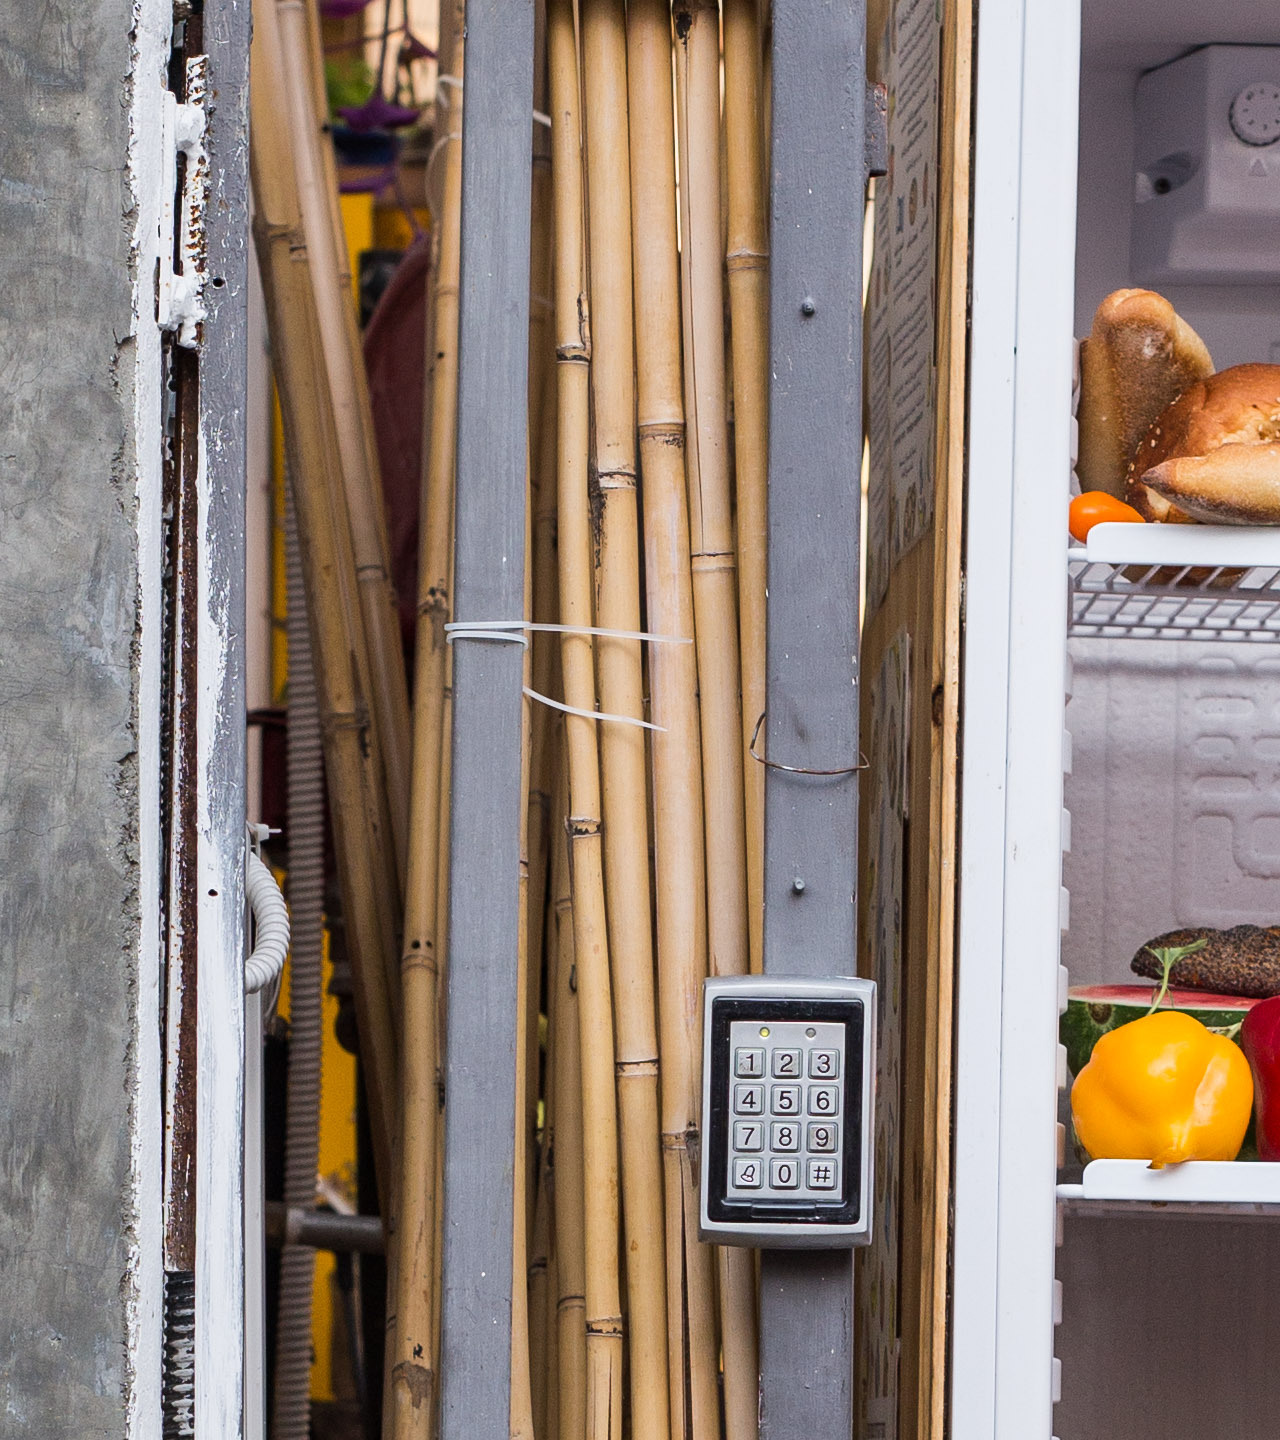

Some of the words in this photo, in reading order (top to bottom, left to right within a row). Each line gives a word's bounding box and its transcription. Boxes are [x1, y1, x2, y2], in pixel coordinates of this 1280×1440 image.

[746, 1054, 756, 1073] 1
[780, 1053, 794, 1073] 2
[817, 1054, 831, 1073] 3
[742, 1091, 756, 1109] 4
[779, 1091, 793, 1110] 5
[816, 1091, 830, 1110] 6
[742, 1127, 755, 1146] 7
[779, 1127, 792, 1147] 8
[816, 1128, 829, 1147] 9
[778, 1164, 791, 1183] 0
[813, 1165, 831, 1182] #
